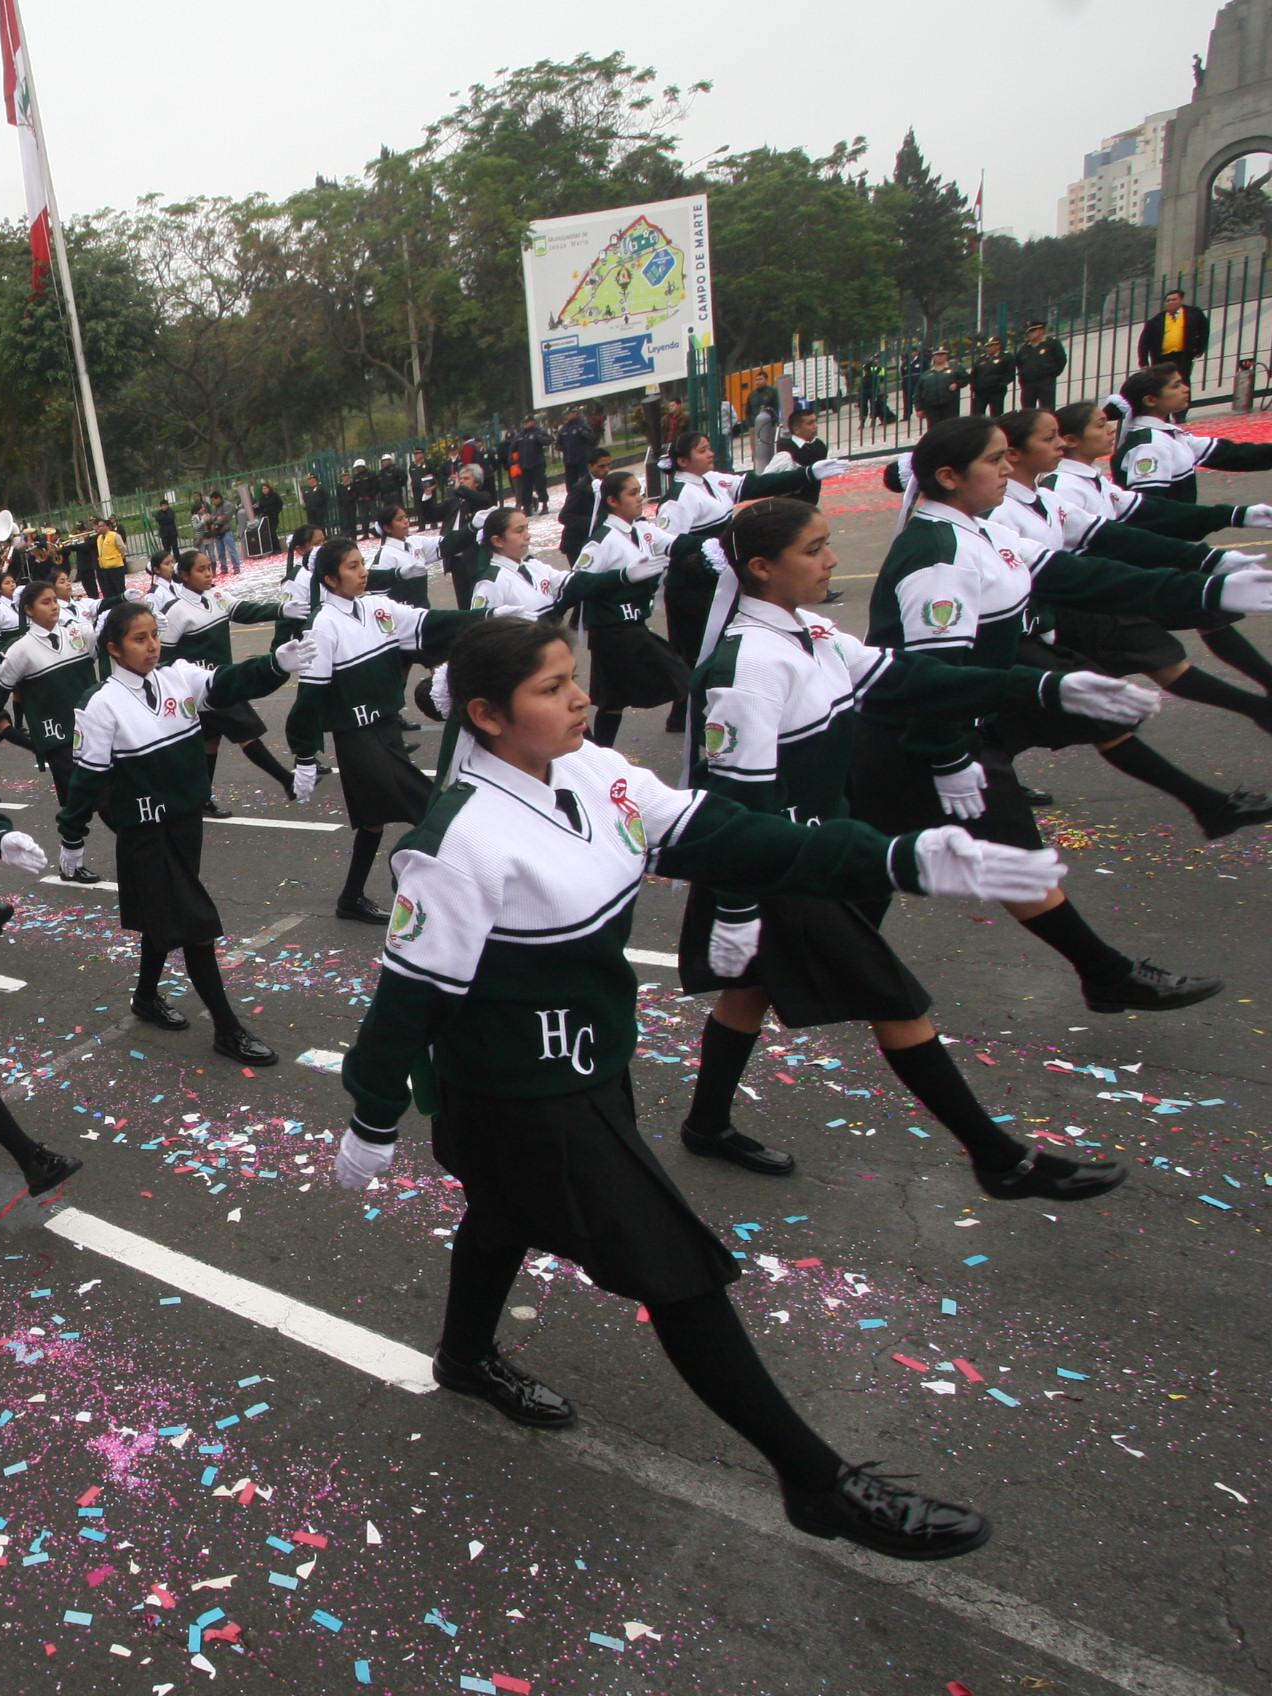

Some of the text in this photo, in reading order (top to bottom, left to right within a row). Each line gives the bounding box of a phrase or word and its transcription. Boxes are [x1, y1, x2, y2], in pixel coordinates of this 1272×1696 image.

[693, 204, 708, 321] CAMPO DE MARTE
[648, 341, 680, 354] Leyenda
[41, 718, 66, 740] HC
[535, 1008, 594, 1075] HC
